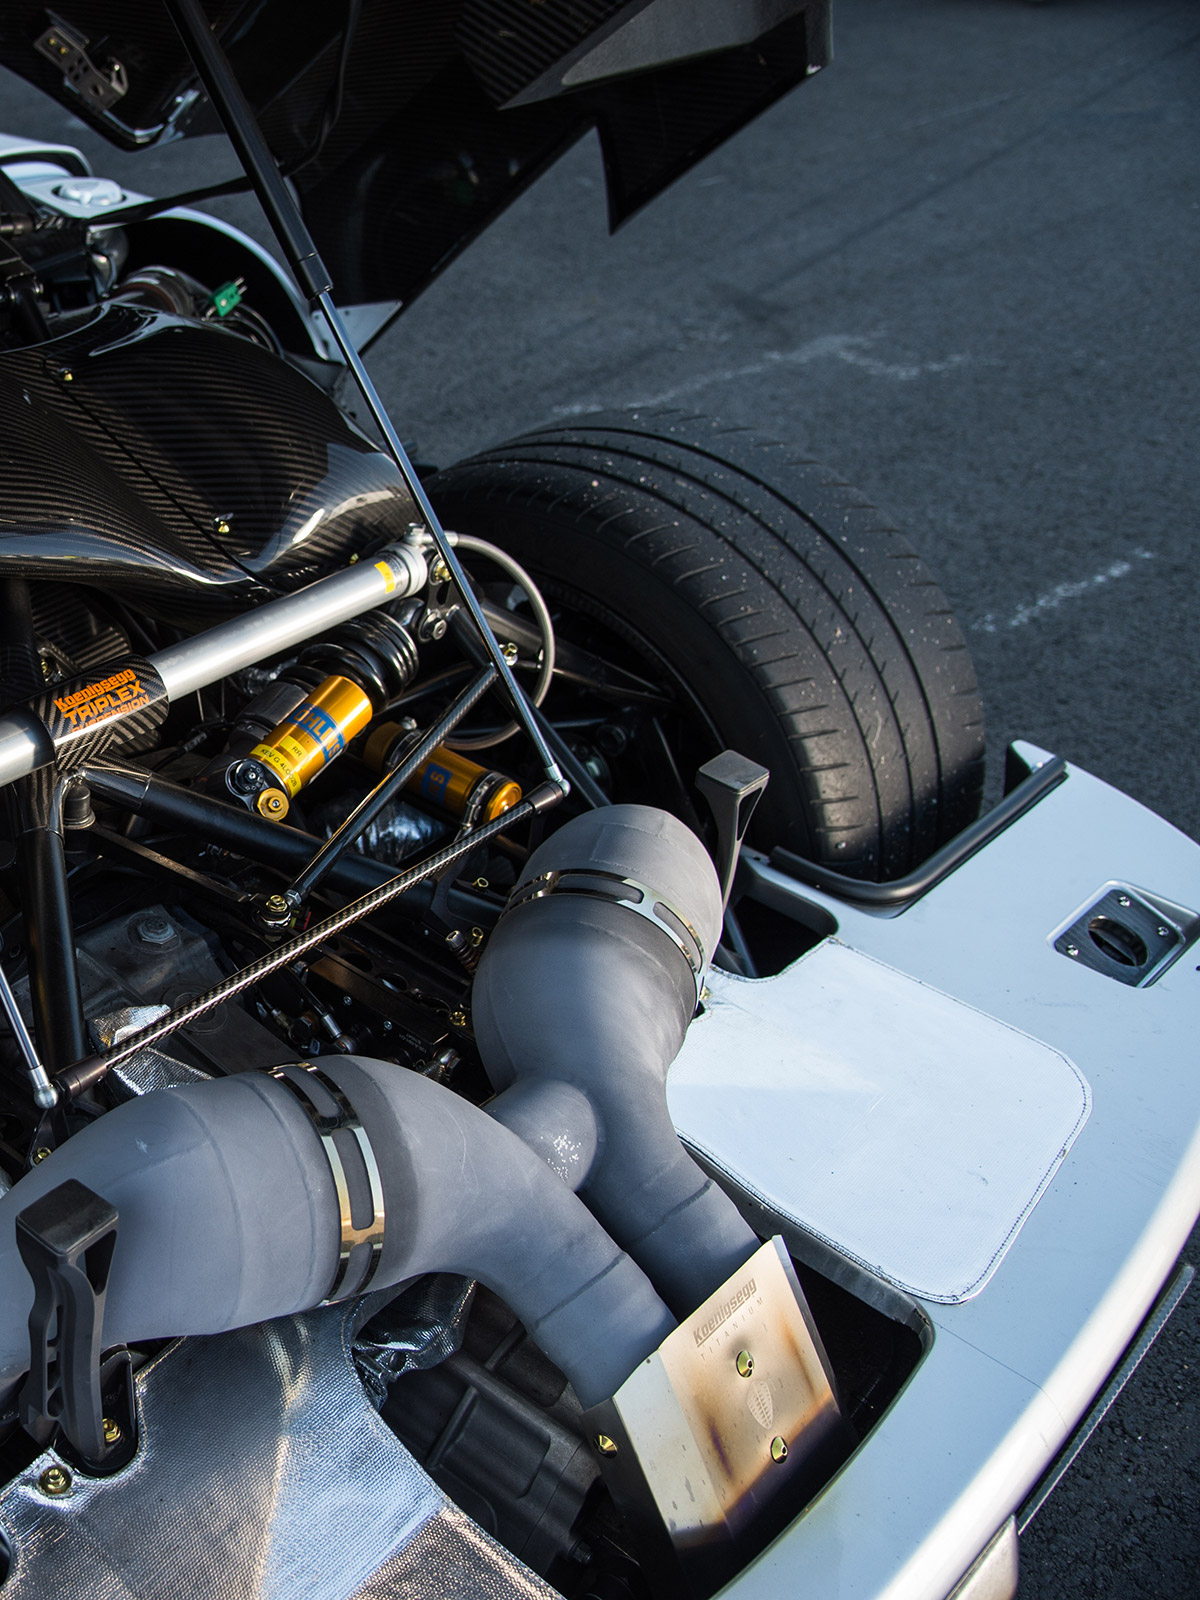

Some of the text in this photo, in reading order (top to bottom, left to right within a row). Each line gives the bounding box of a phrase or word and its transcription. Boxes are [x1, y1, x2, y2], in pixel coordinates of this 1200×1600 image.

[53, 668, 137, 712] Koenigsegg
[64, 680, 146, 725] TRIPLEX
[292, 746, 302, 756] RR
[693, 1277, 757, 1347] Koenigsegg
[701, 1296, 763, 1360] TITANIUM
